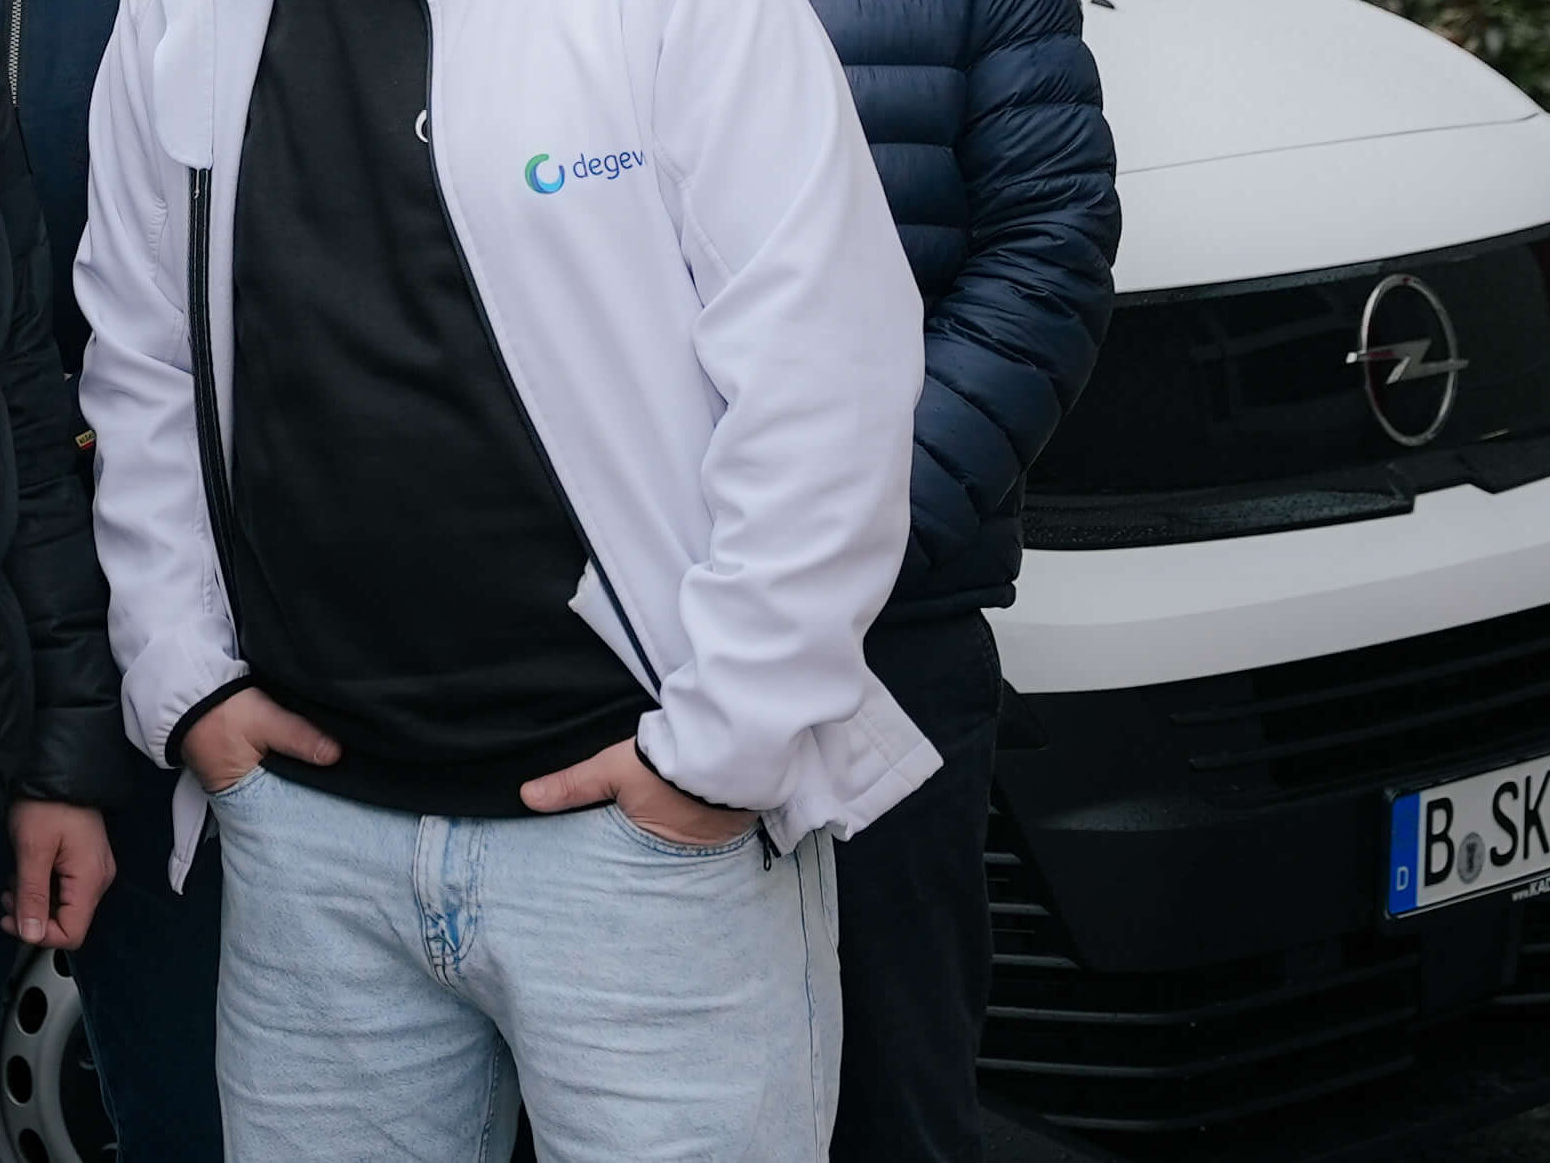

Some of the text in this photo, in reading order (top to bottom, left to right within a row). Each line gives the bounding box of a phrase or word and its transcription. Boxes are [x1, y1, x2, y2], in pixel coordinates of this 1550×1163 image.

[572, 149, 645, 180] degew
[1424, 796, 1455, 887] B
[1396, 865, 1410, 891] D
